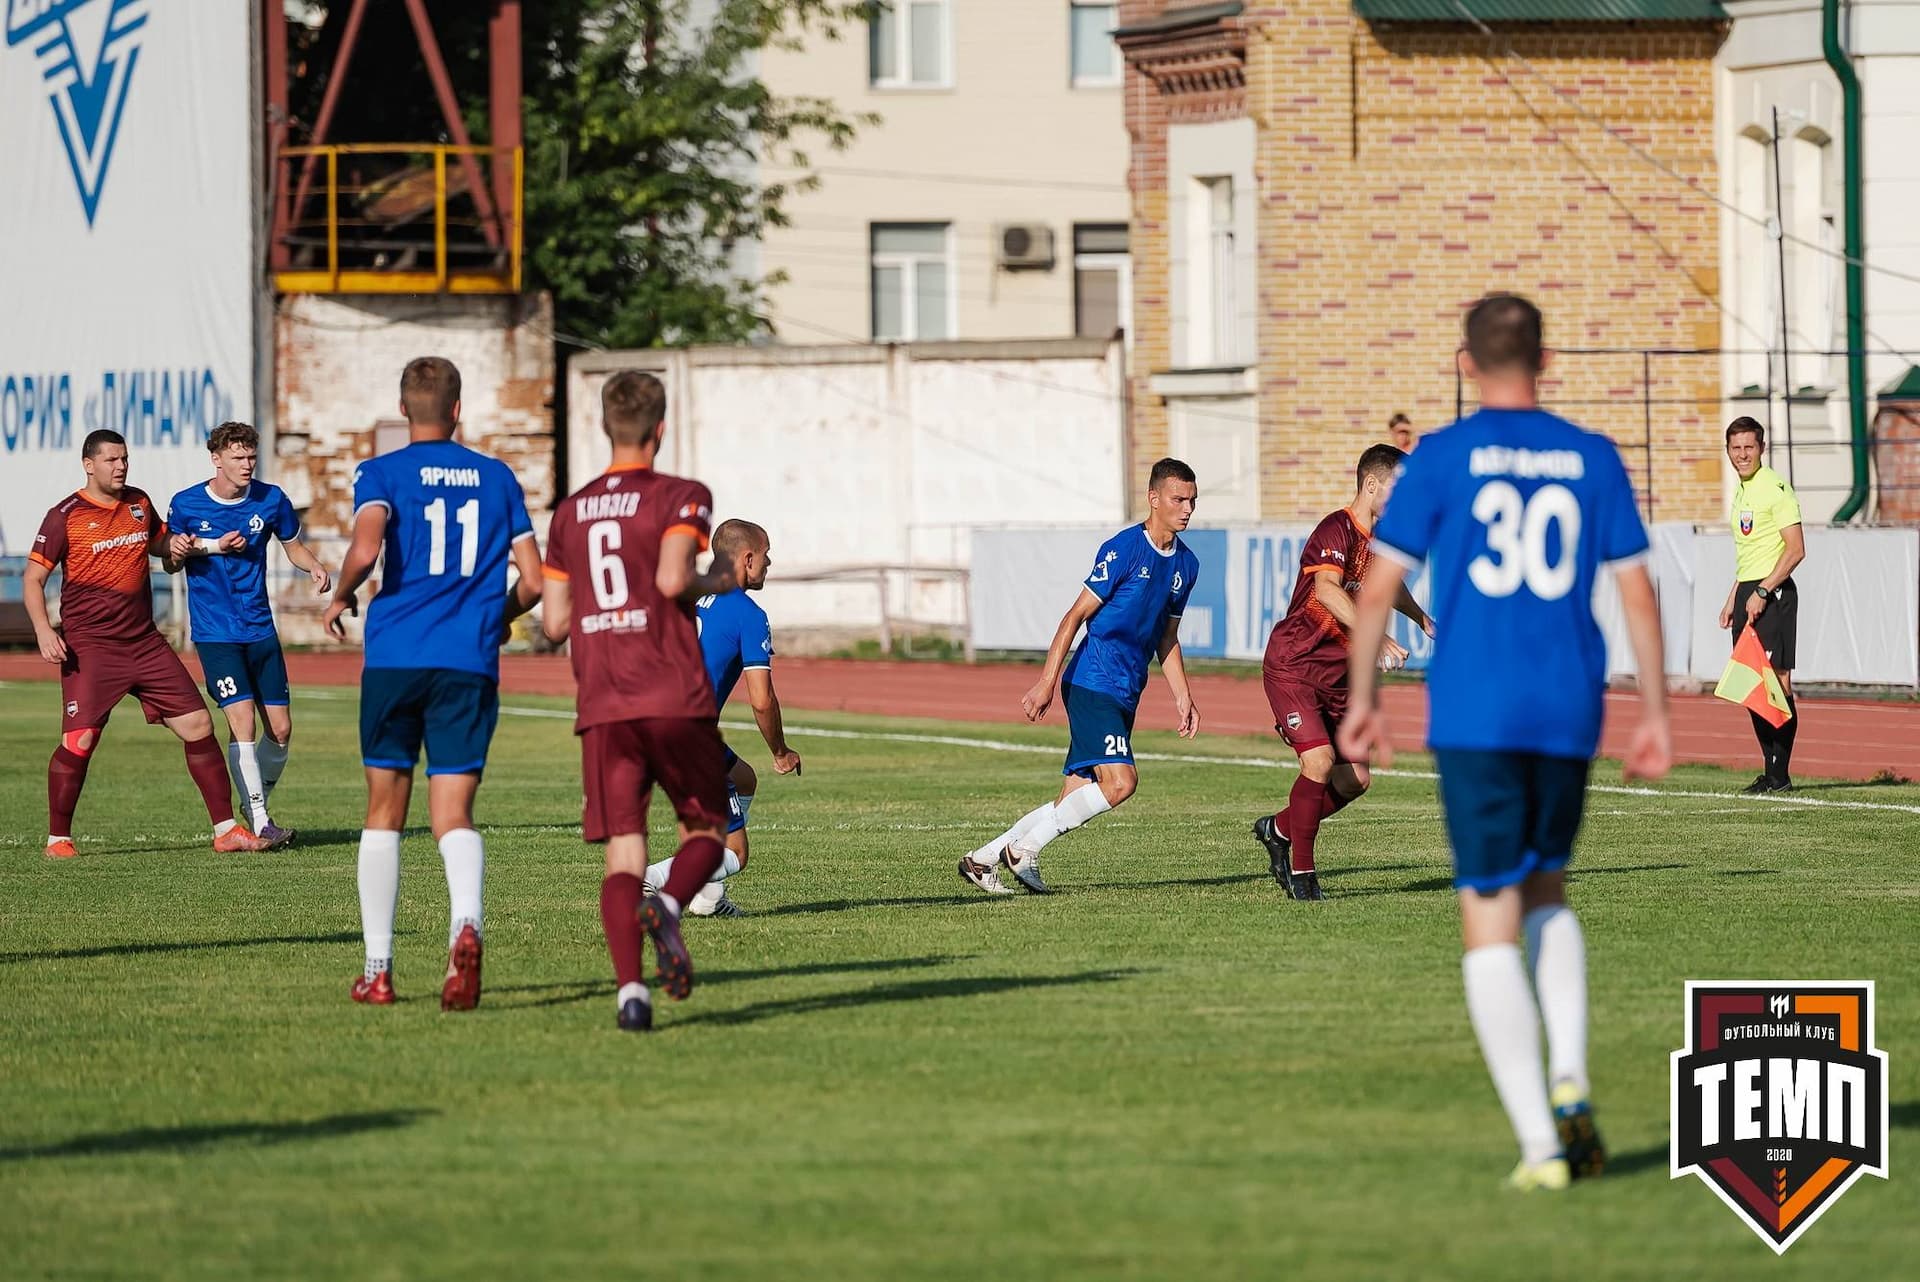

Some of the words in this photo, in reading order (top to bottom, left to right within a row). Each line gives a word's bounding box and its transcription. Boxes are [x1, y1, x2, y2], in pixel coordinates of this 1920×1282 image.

[420, 467, 481, 488] ЯРКИН
[424, 498, 480, 577] 11
[588, 520, 629, 610] 6
[1467, 480, 1582, 600] 30
[1245, 537, 1306, 649] ГАЗ
[216, 676, 238, 698] 33
[1104, 734, 1128, 757] 24
